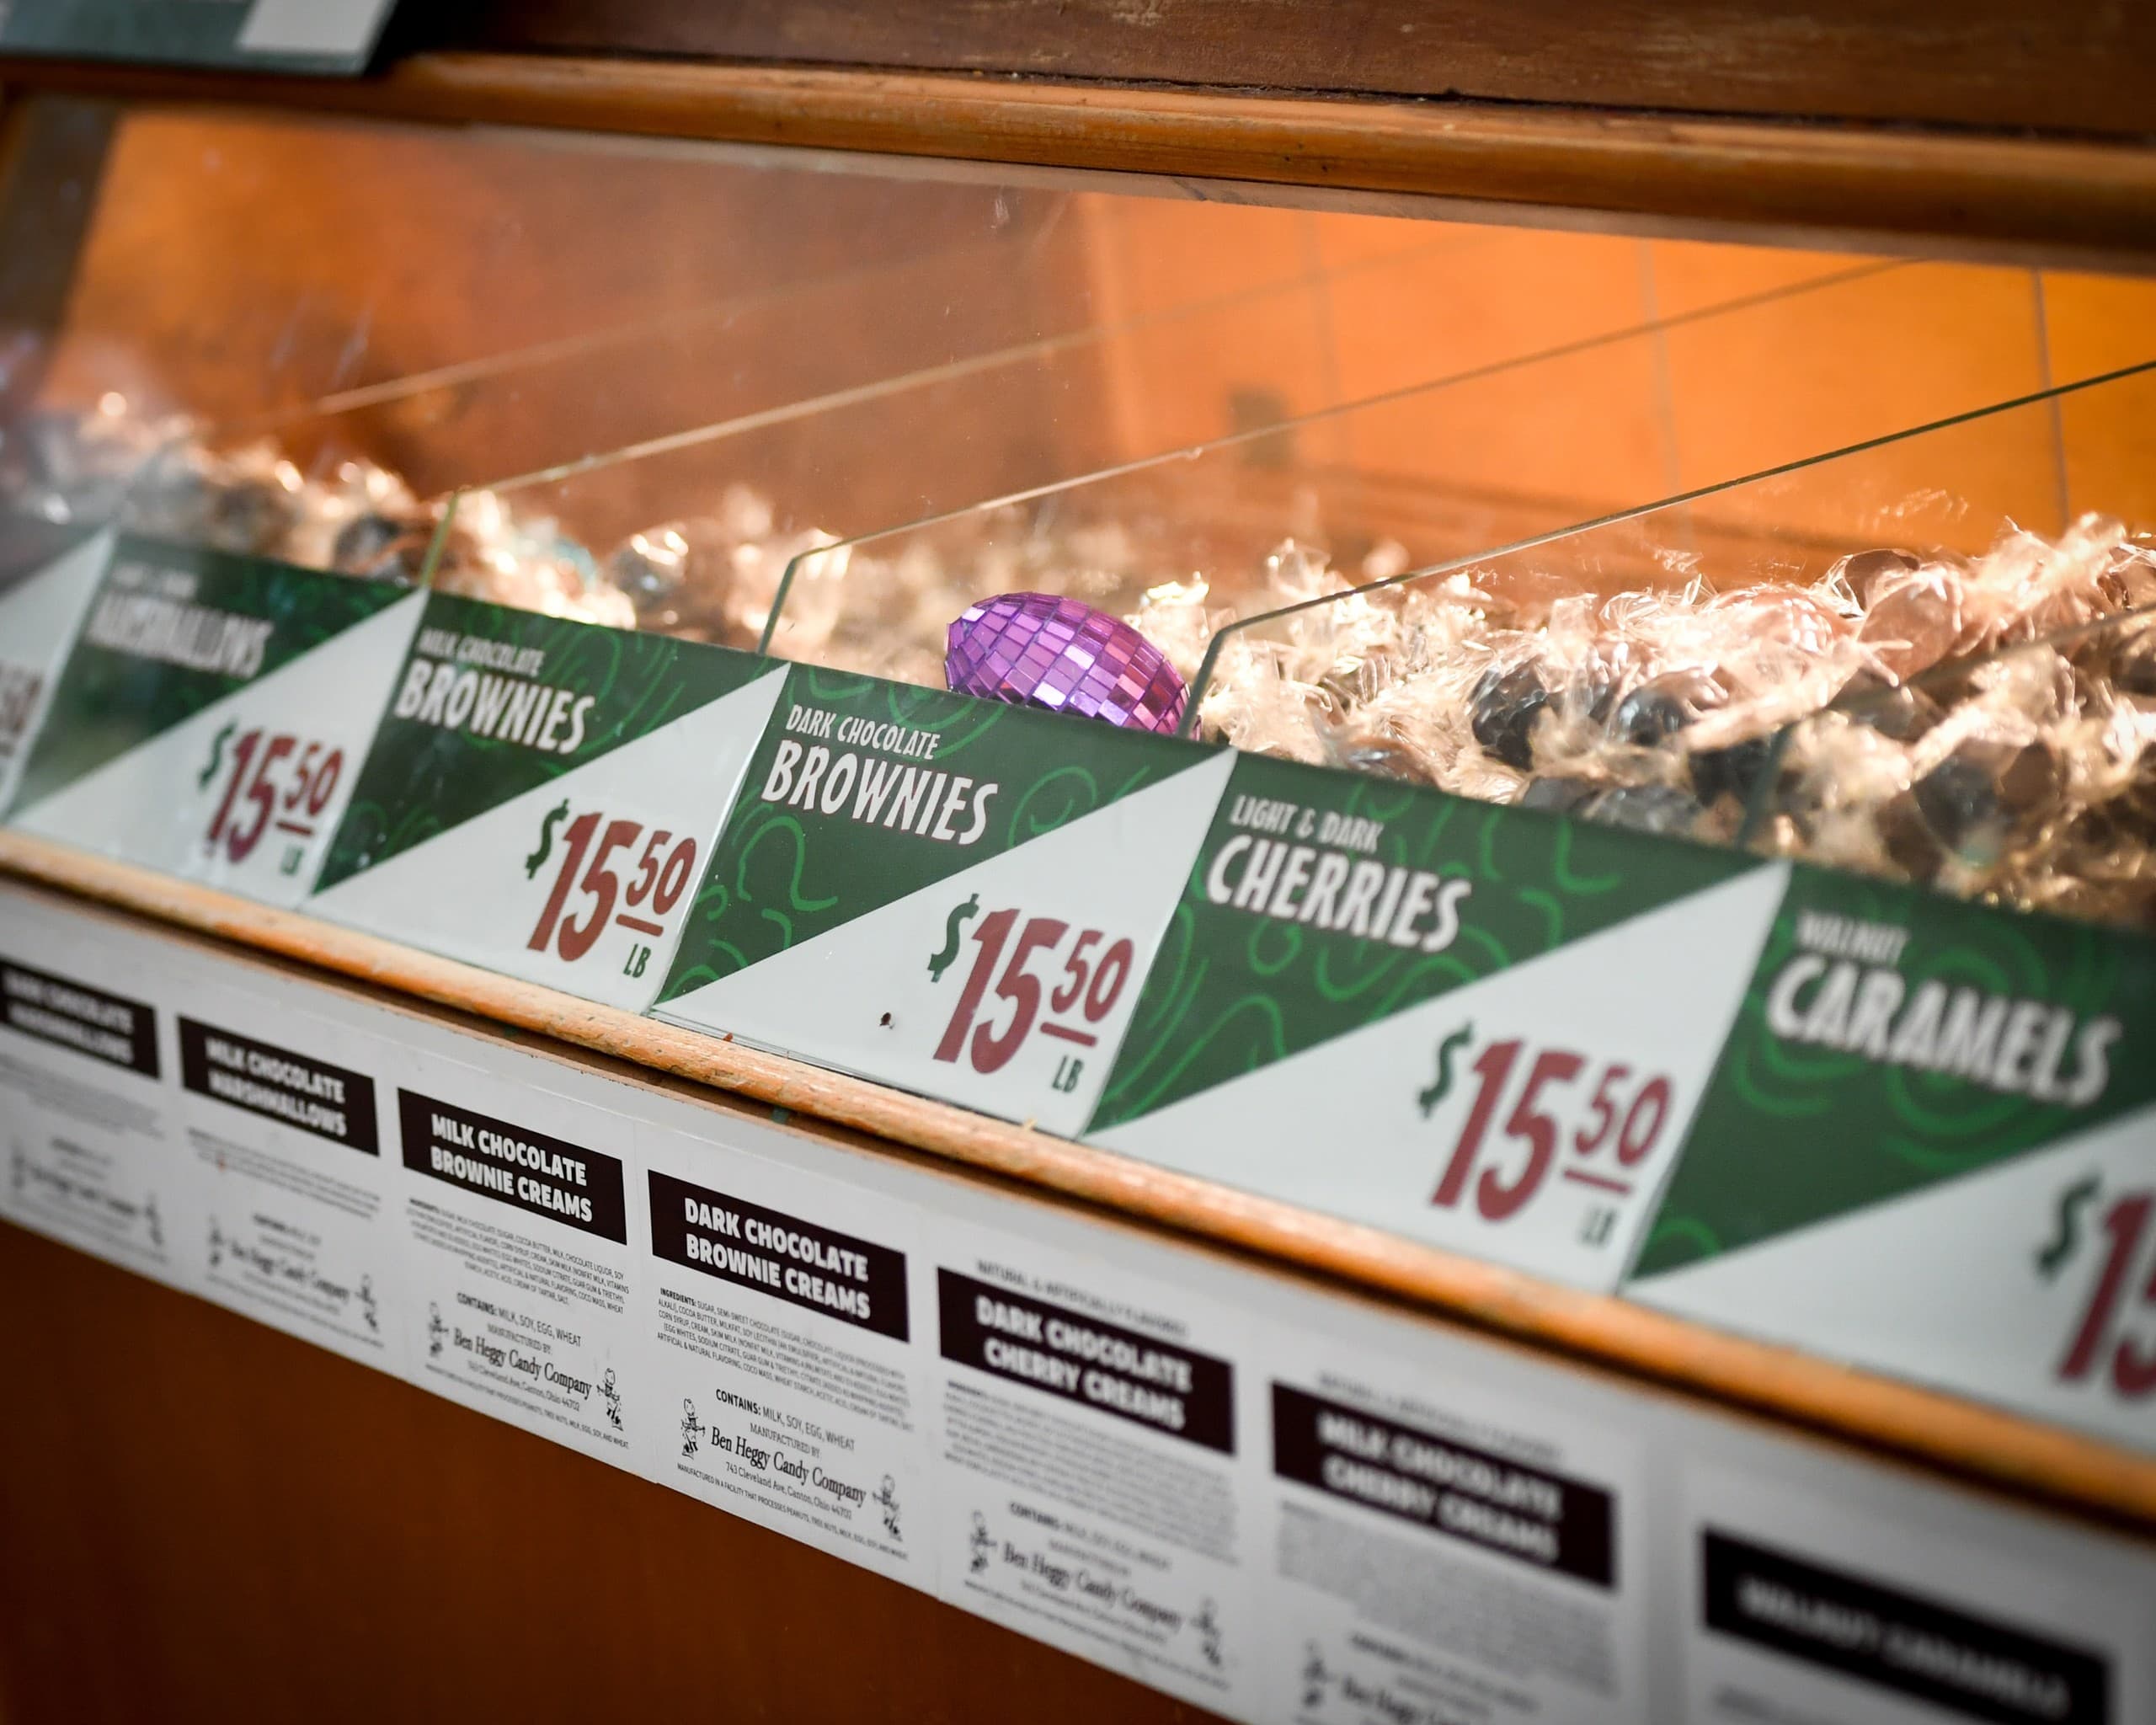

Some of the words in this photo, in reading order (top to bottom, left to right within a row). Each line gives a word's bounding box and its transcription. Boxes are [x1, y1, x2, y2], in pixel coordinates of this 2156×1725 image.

[419, 628, 459, 657] MILK
[460, 636, 546, 676] CHOCOLATE
[394, 658, 595, 755] BROWNIES
[785, 704, 837, 740] DARK
[837, 715, 941, 761] CHOCOLATE
[760, 740, 999, 846] BROWNIES
[1229, 794, 1294, 834] LIGHT
[1295, 809, 1315, 838] &
[1318, 811, 1384, 853] DARK
[1205, 834, 1472, 953] CHERRIES
[623, 943, 653, 979] LB
[1796, 911, 1908, 965] WALNUT
[1766, 951, 2122, 1106] CARAMELS
[205, 1037, 244, 1067] MILK
[247, 1050, 345, 1104] CHOCOLATE
[1050, 1055, 1086, 1093] LB
[431, 1113, 475, 1149] MILK
[478, 1130, 587, 1186] CHOCOLATE
[430, 1146, 515, 1195] BROWNIE
[517, 1176, 593, 1222] CREAMS
[685, 1198, 741, 1239] DARK
[744, 1218, 869, 1282] CHOCOLATE
[660, 1287, 696, 1306] INGREDIENTS:
[697, 1300, 716, 1315] SUGAR,
[686, 1232, 782, 1288] BROWNIE
[785, 1267, 871, 1320] CREAMS
[457, 1291, 496, 1316] CONTAINS:
[499, 1306, 518, 1325] MILK,
[519, 1314, 536, 1332] SOY,
[536, 1320, 555, 1339] EGG,
[556, 1327, 581, 1348] WHEAT
[487, 1322, 541, 1351] MANUFACTURED
[606, 1301, 623, 1315] WHEAT
[659, 1309, 672, 1322] CORN
[674, 1314, 691, 1329] SYRUP,
[691, 1321, 709, 1336] CREAM,
[711, 1328, 723, 1340] SKIM
[724, 1332, 736, 1344] MILK
[679, 1305, 696, 1318] COCOA
[696, 1311, 718, 1327] BUTTER,
[454, 1326, 472, 1352] Ben
[475, 1335, 506, 1370] Heggy
[509, 1347, 542, 1383] Candy
[544, 1360, 591, 1402] Company
[657, 1331, 682, 1348] ARTIFICIAL
[688, 1342, 711, 1359] NATURAL
[712, 1351, 742, 1370] FLAVORING,
[676, 1327, 697, 1343] WHITES,
[697, 1334, 718, 1349] SODIUM
[976, 1295, 1043, 1342] DARK
[1046, 1318, 1193, 1393] CHOCOLATE
[984, 1338, 1081, 1391] CHERRY
[1082, 1371, 1186, 1431] CREAMS
[715, 1387, 760, 1416] CONTAINS:
[762, 1405, 784, 1425] MILK,
[786, 1414, 804, 1434] SOY,
[805, 1422, 825, 1442] EGG,
[825, 1429, 855, 1452] WHEAT
[750, 1422, 810, 1455] MANUFACTURED
[677, 1461, 714, 1484] MANUFACTURED
[724, 1481, 744, 1496] FACILITY
[745, 1489, 756, 1500] THAT
[711, 1424, 732, 1452] Ben
[735, 1434, 771, 1473] Heggy
[773, 1449, 808, 1487] Candy
[812, 1464, 866, 1510] Company
[726, 1461, 738, 1475] 743
[738, 1466, 771, 1488] Cleveland
[787, 1485, 813, 1504] Canton,
[814, 1495, 830, 1511] Ohio
[1317, 1410, 1388, 1459] MILK
[1391, 1429, 1564, 1525] CHOCOLATE
[1321, 1453, 1436, 1519] CHERRY
[1437, 1488, 1559, 1564] CREAMS
